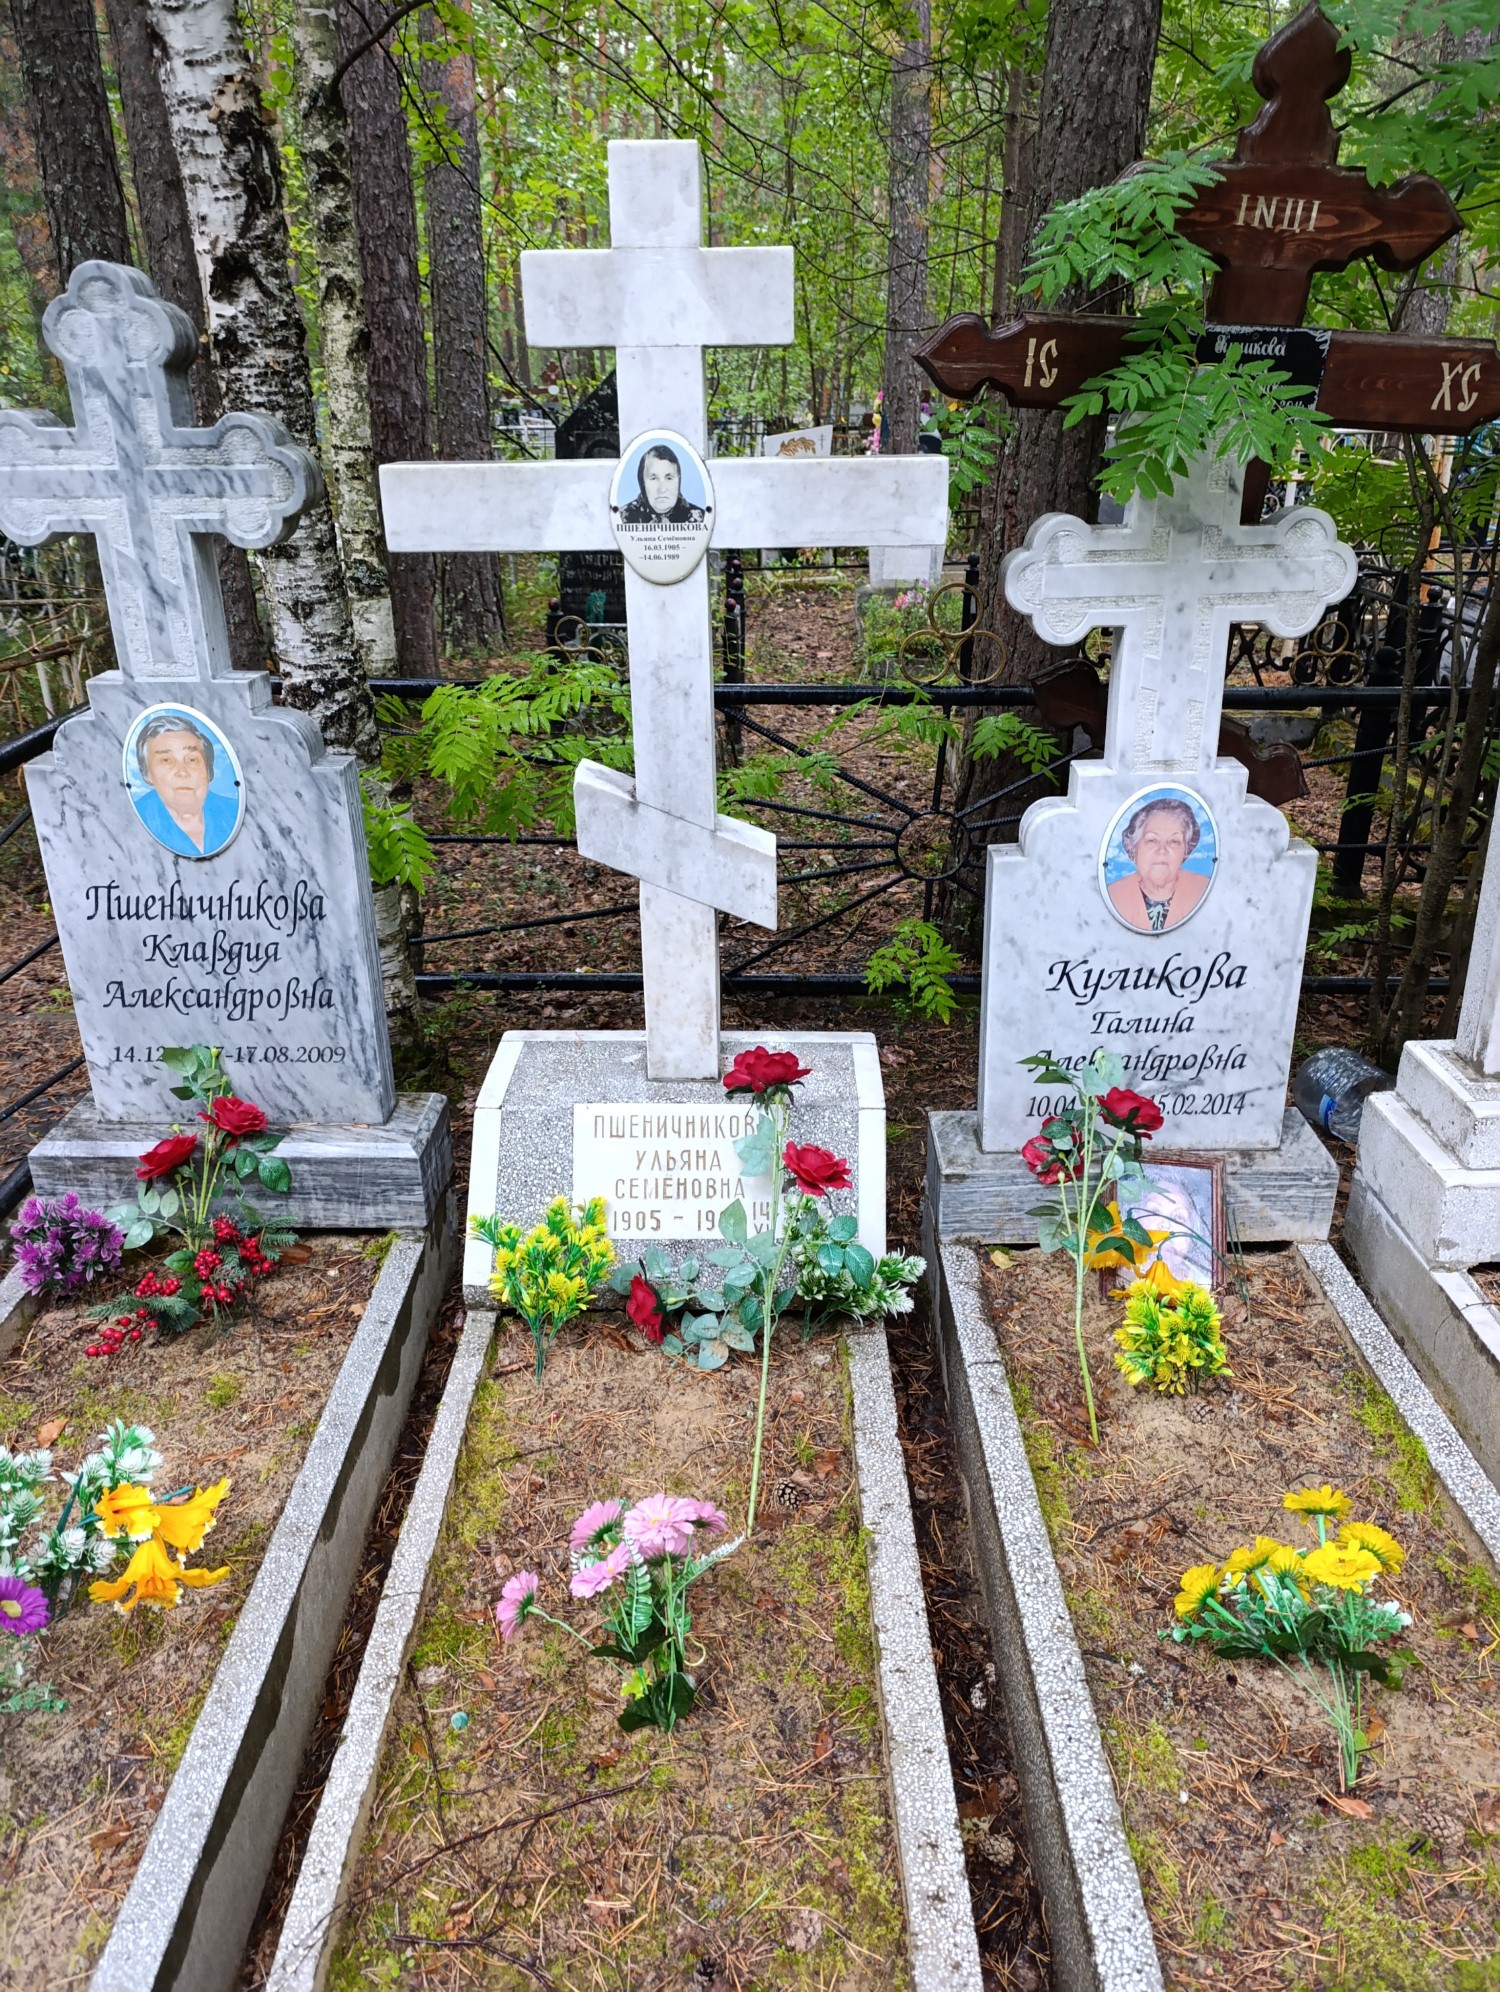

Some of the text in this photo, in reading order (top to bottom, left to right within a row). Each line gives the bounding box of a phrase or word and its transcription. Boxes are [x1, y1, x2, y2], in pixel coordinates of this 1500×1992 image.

[616, 523, 709, 532] ПШЕНИЧНИКОВА
[85, 879, 327, 937] Пшеничникова
[142, 929, 282, 975] Клавдия
[1045, 951, 1249, 1006] Куликова
[102, 976, 336, 1022] Александровна
[1090, 1006, 1195, 1035] Галина
[594, 1115, 757, 1139] ПШЕНИЧНИКОВ
[636, 1150, 722, 1171] УЛЬЯНА
[613, 1210, 661, 1232] 1905
